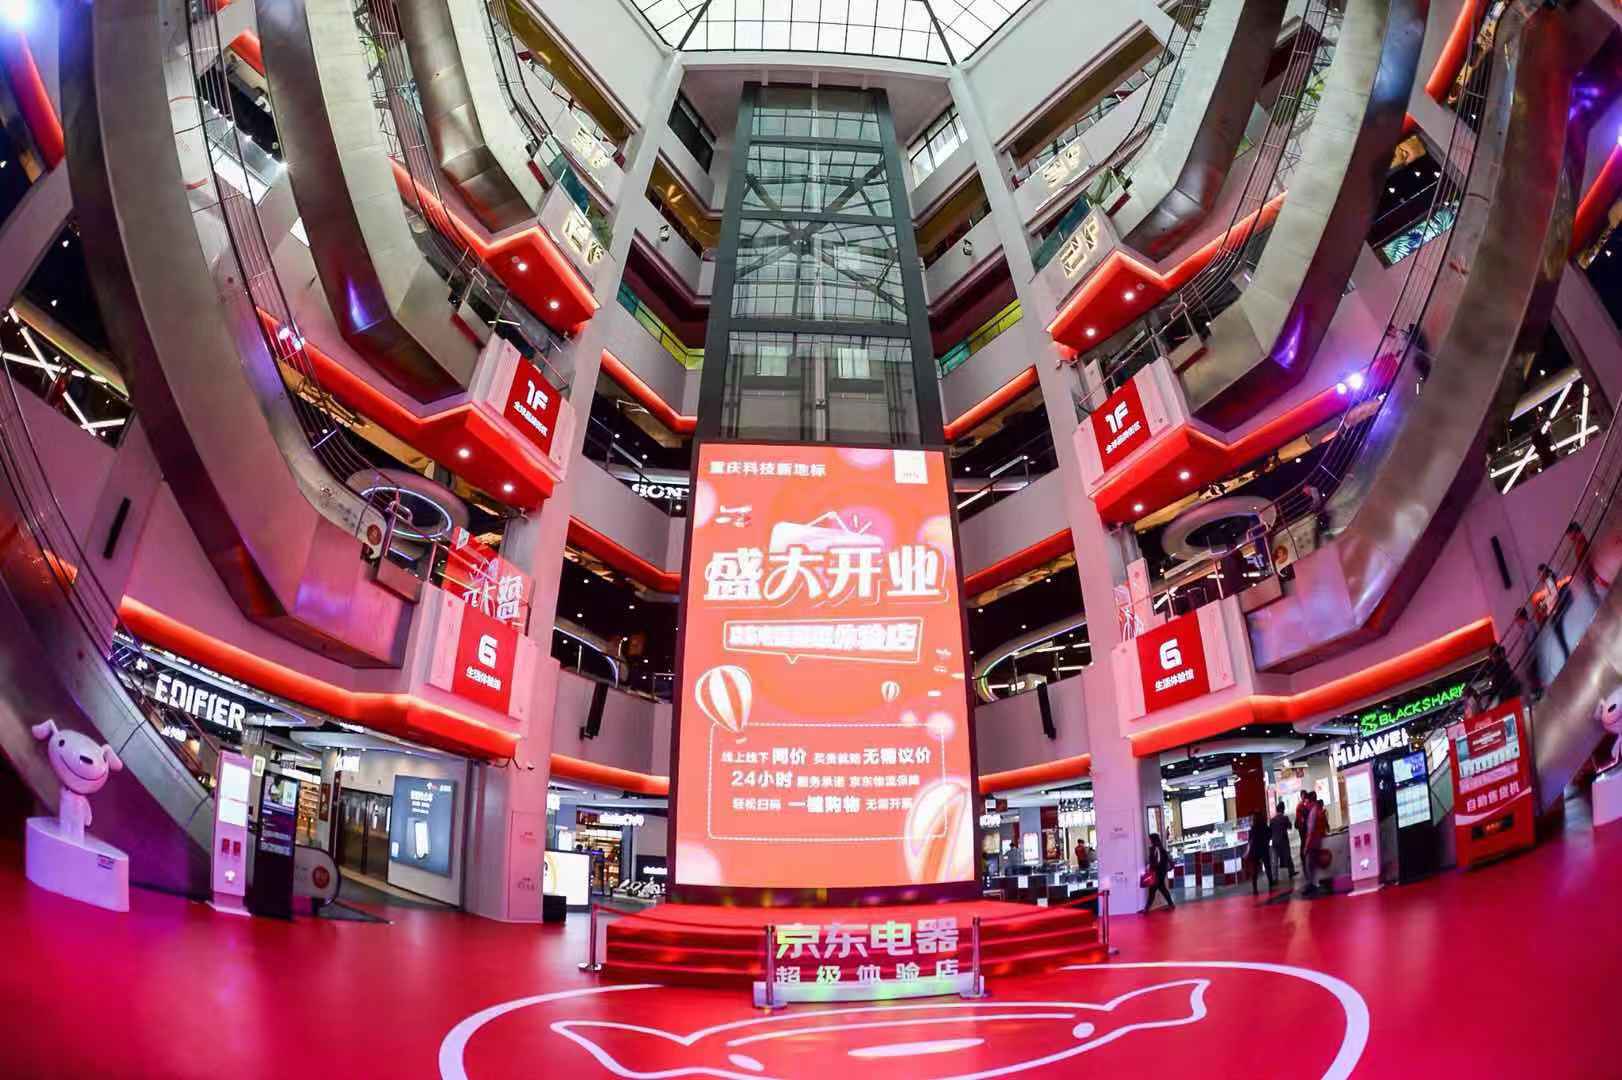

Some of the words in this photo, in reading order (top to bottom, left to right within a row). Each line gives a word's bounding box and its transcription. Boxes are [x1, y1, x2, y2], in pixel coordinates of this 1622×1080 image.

[526, 379, 549, 411] 1F
[1104, 400, 1129, 433] 1F
[709, 460, 826, 478] 重庆科技新地标
[703, 545, 942, 602] 盛大开业
[154, 672, 246, 732] EDIFIER
[772, 747, 806, 765] 同价
[863, 747, 931, 765] 无需议价
[1333, 728, 1409, 768] HUAWEI
[731, 770, 793, 788] 24小时
[776, 917, 959, 959] 京东电器
[776, 959, 959, 984] 超级体验店
